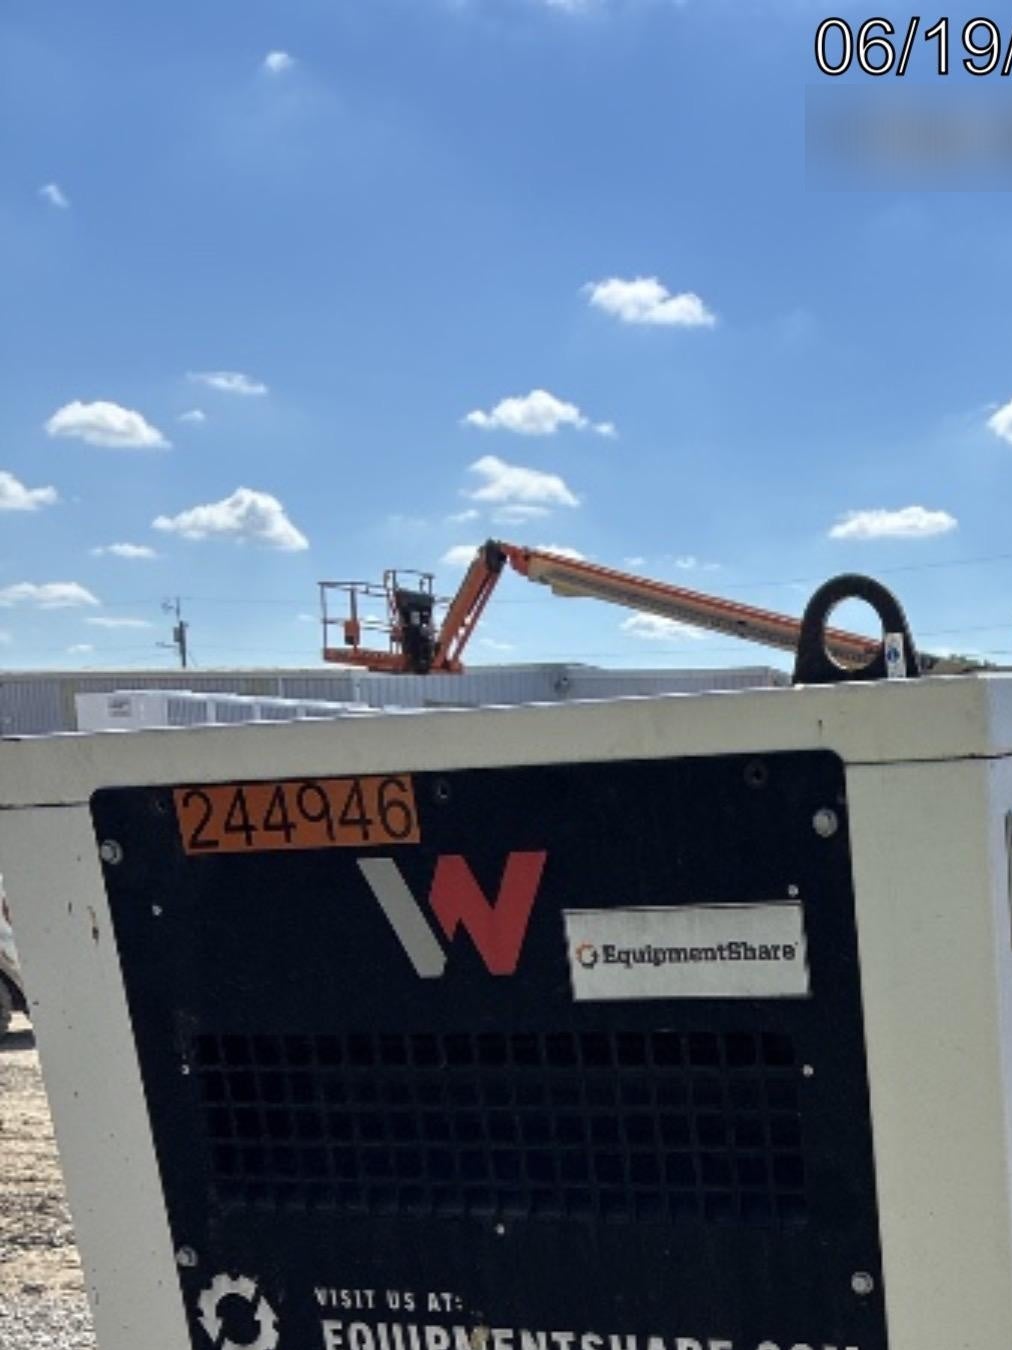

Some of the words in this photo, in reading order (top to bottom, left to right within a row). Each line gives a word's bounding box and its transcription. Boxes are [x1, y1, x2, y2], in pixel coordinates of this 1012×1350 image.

[182, 779, 412, 849] 244946
[602, 941, 800, 970] EquipmentShare
[314, 1286, 376, 1310] VISIT
[386, 1289, 416, 1312] US
[428, 1292, 464, 1313] AT:
